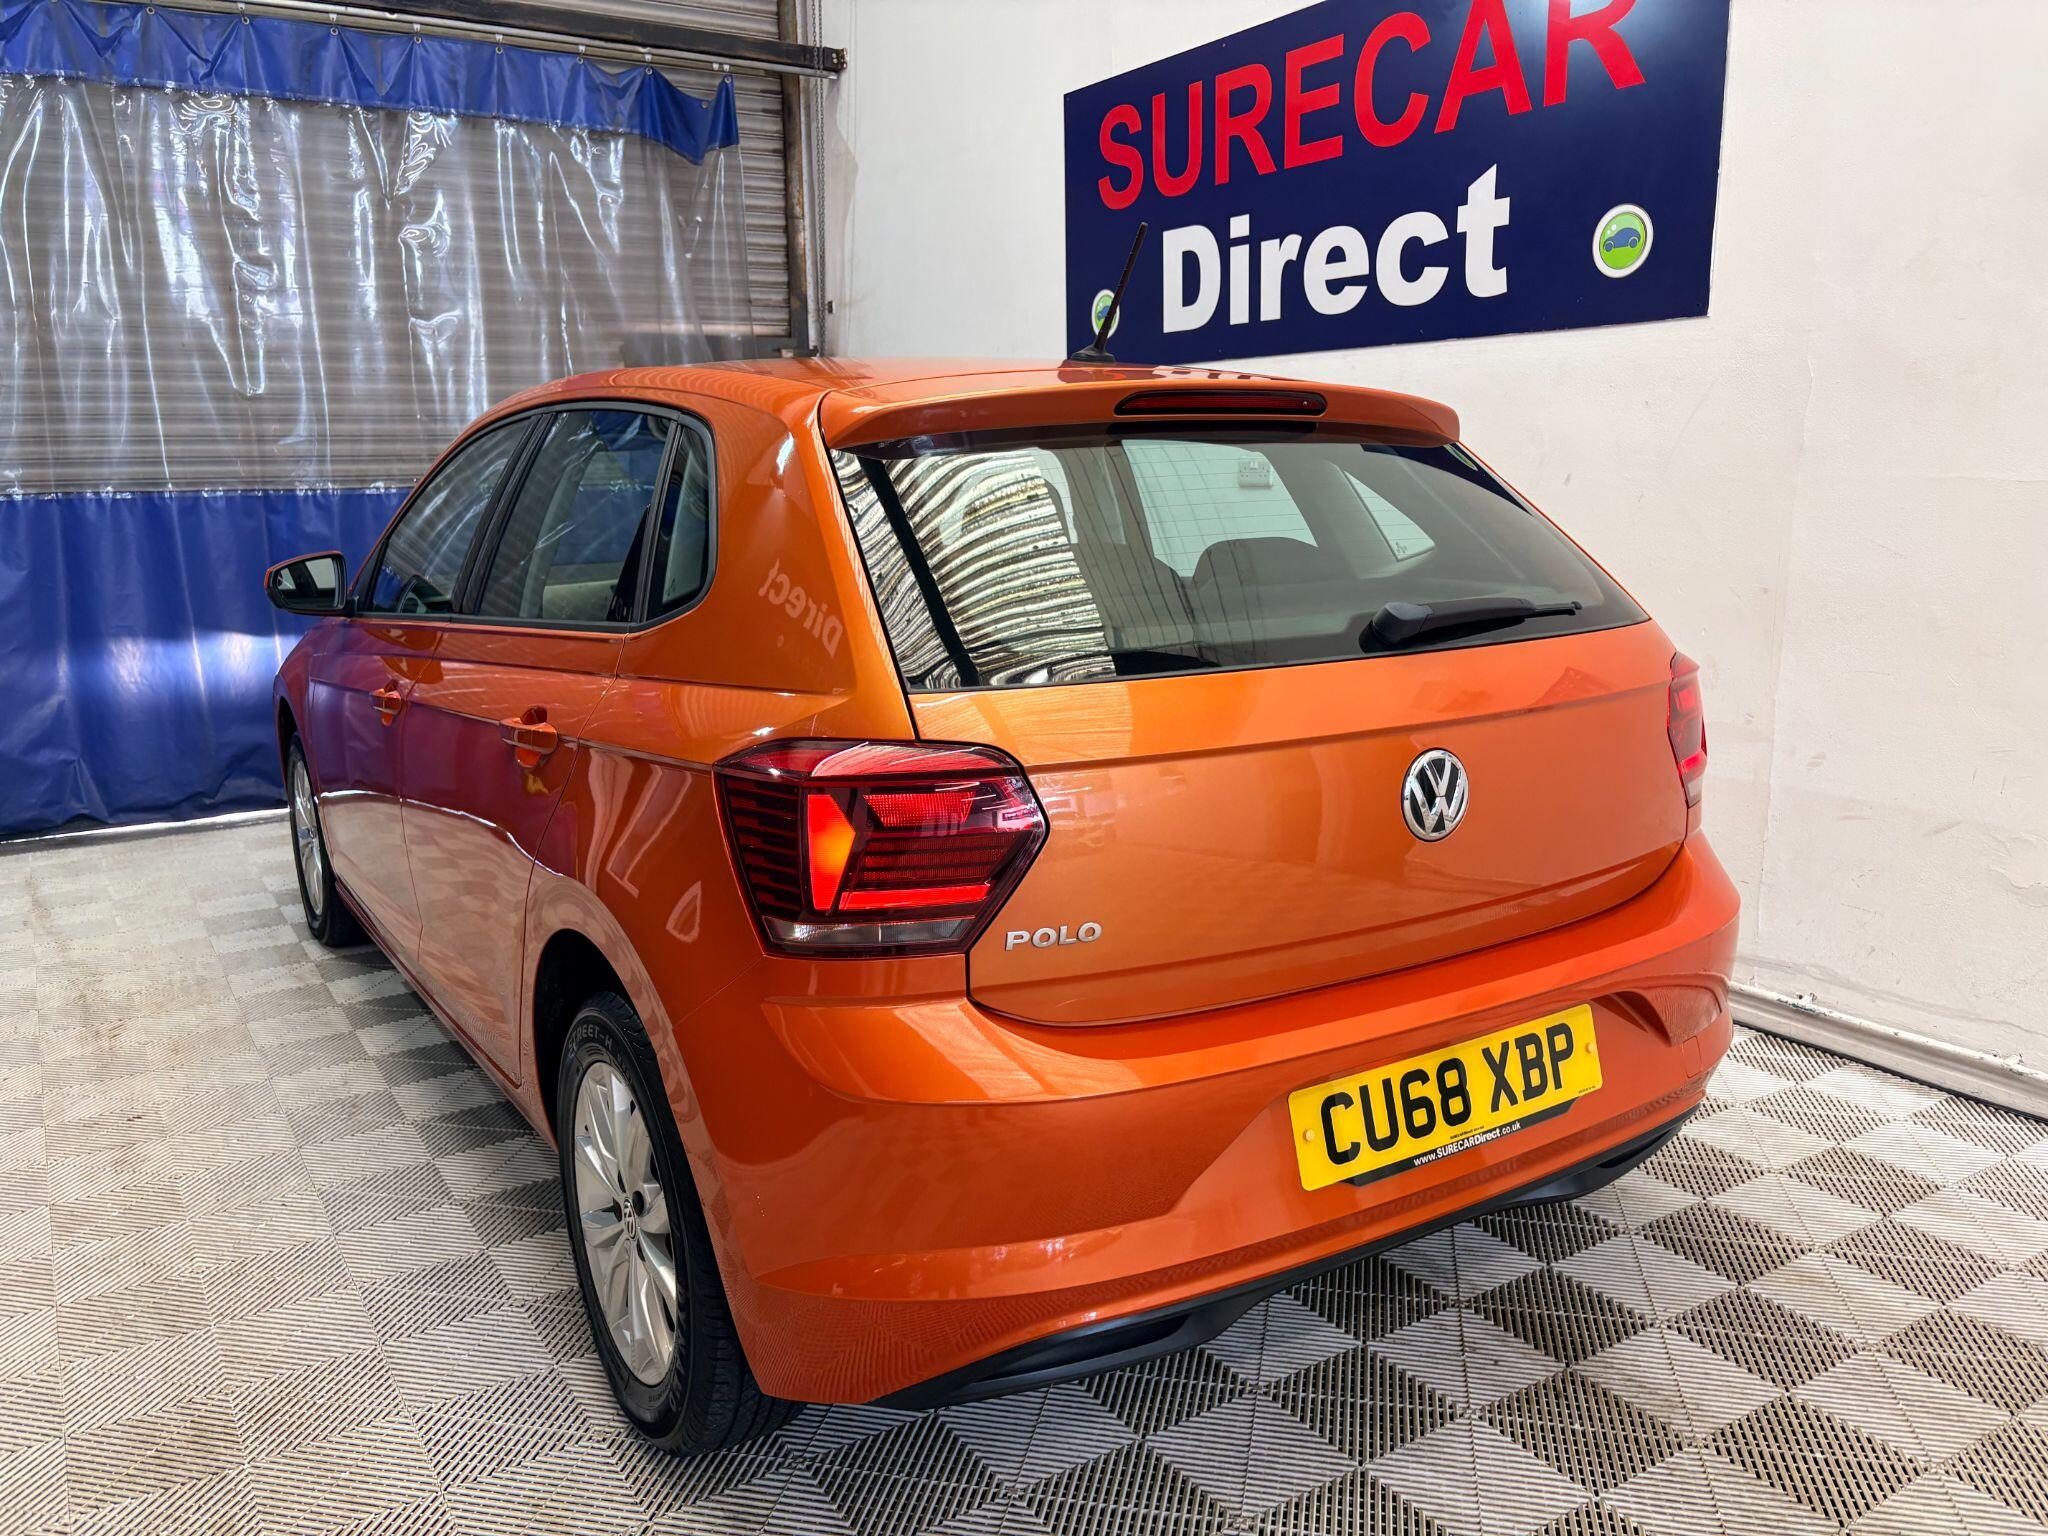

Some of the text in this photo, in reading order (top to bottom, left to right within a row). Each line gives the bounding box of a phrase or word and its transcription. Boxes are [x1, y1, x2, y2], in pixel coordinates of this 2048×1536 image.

[1098, 0, 1647, 210] SURECAR
[1162, 163, 1510, 334] Direct
[1005, 922, 1103, 951] POLO
[1320, 1022, 1575, 1165] CU68 XBP
